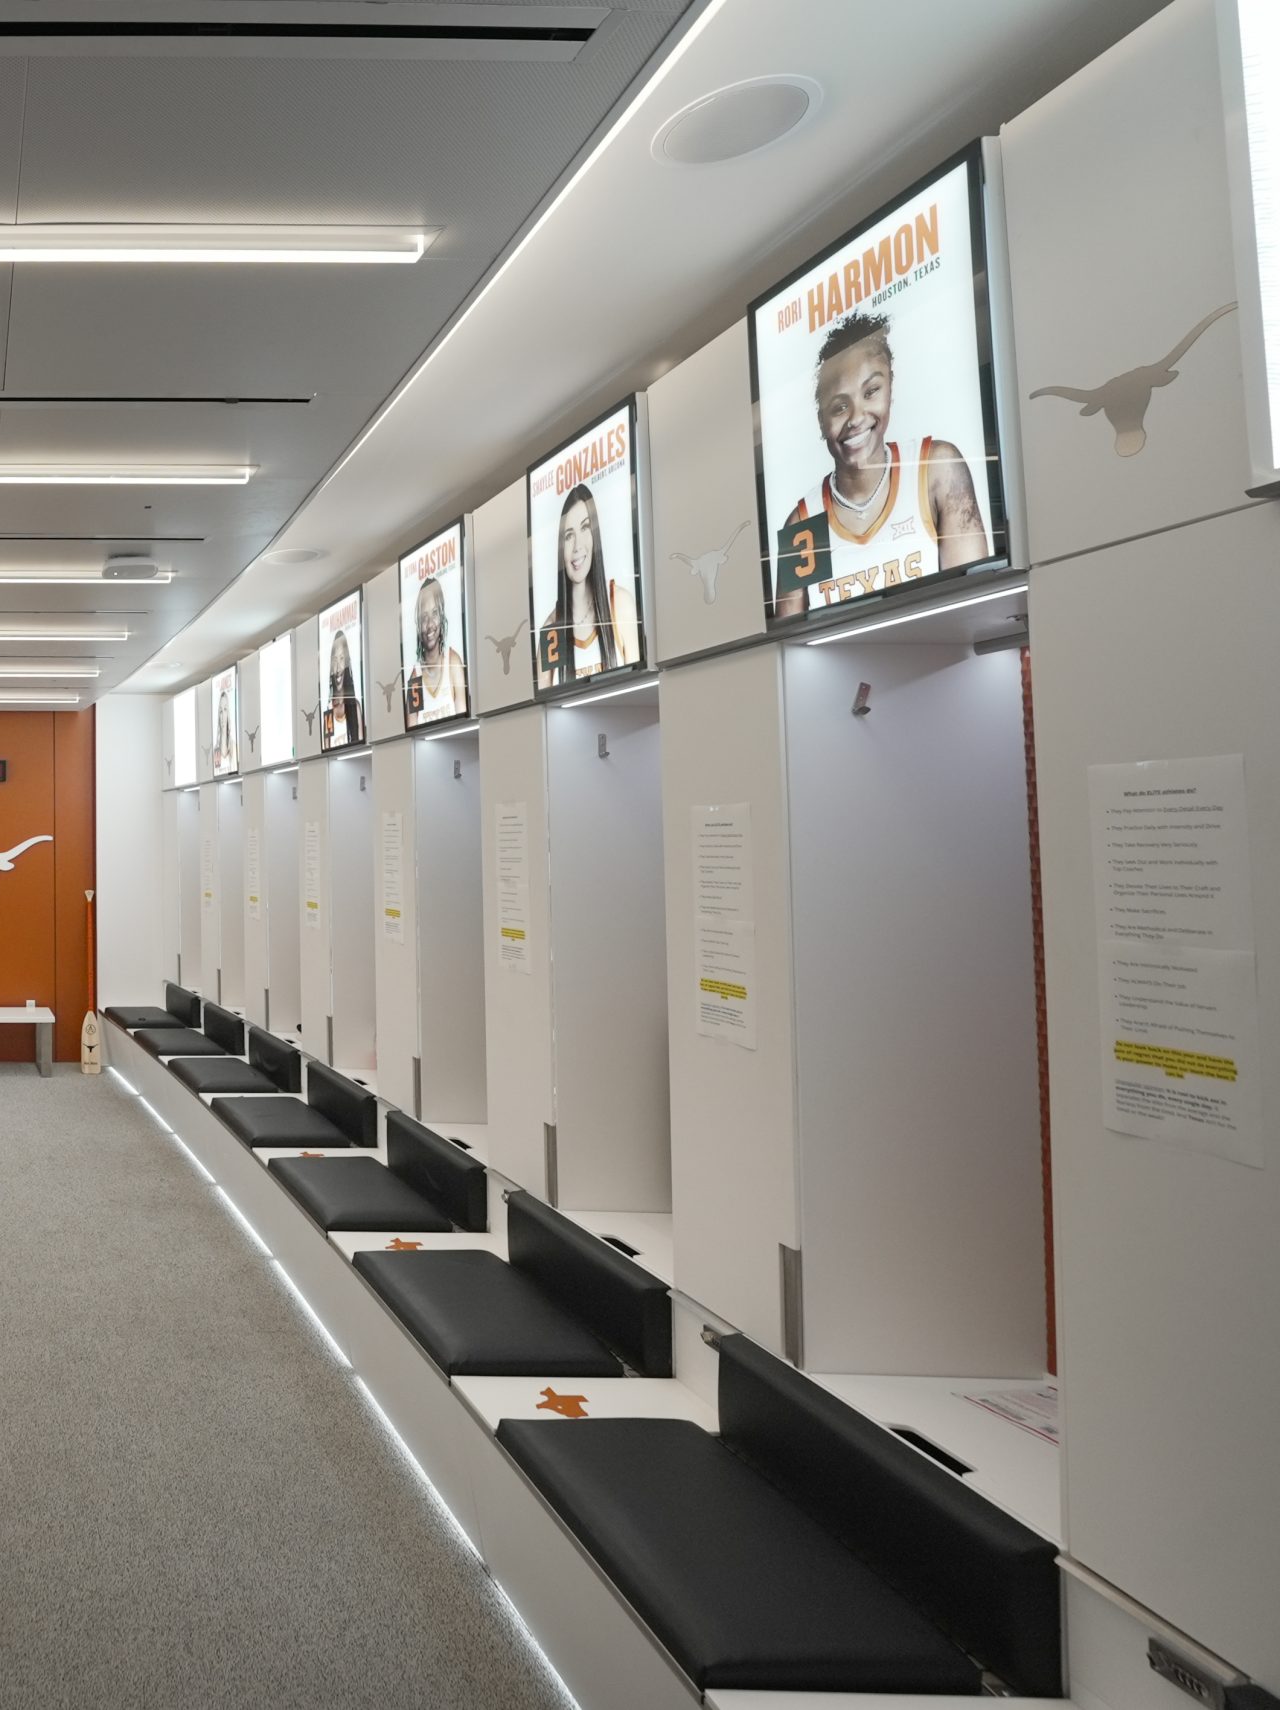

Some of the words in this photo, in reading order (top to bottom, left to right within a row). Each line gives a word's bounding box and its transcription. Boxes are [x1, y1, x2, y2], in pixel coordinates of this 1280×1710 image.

[777, 296, 802, 335] RORI
[807, 203, 940, 334] HARMON
[914, 256, 941, 282] TEXAS
[556, 423, 626, 496] GONZALES
[418, 537, 456, 580] GASTON
[792, 529, 816, 578] 3
[819, 551, 923, 606] TEXAS
[547, 629, 560, 663] 2
[411, 682, 420, 708] 5
